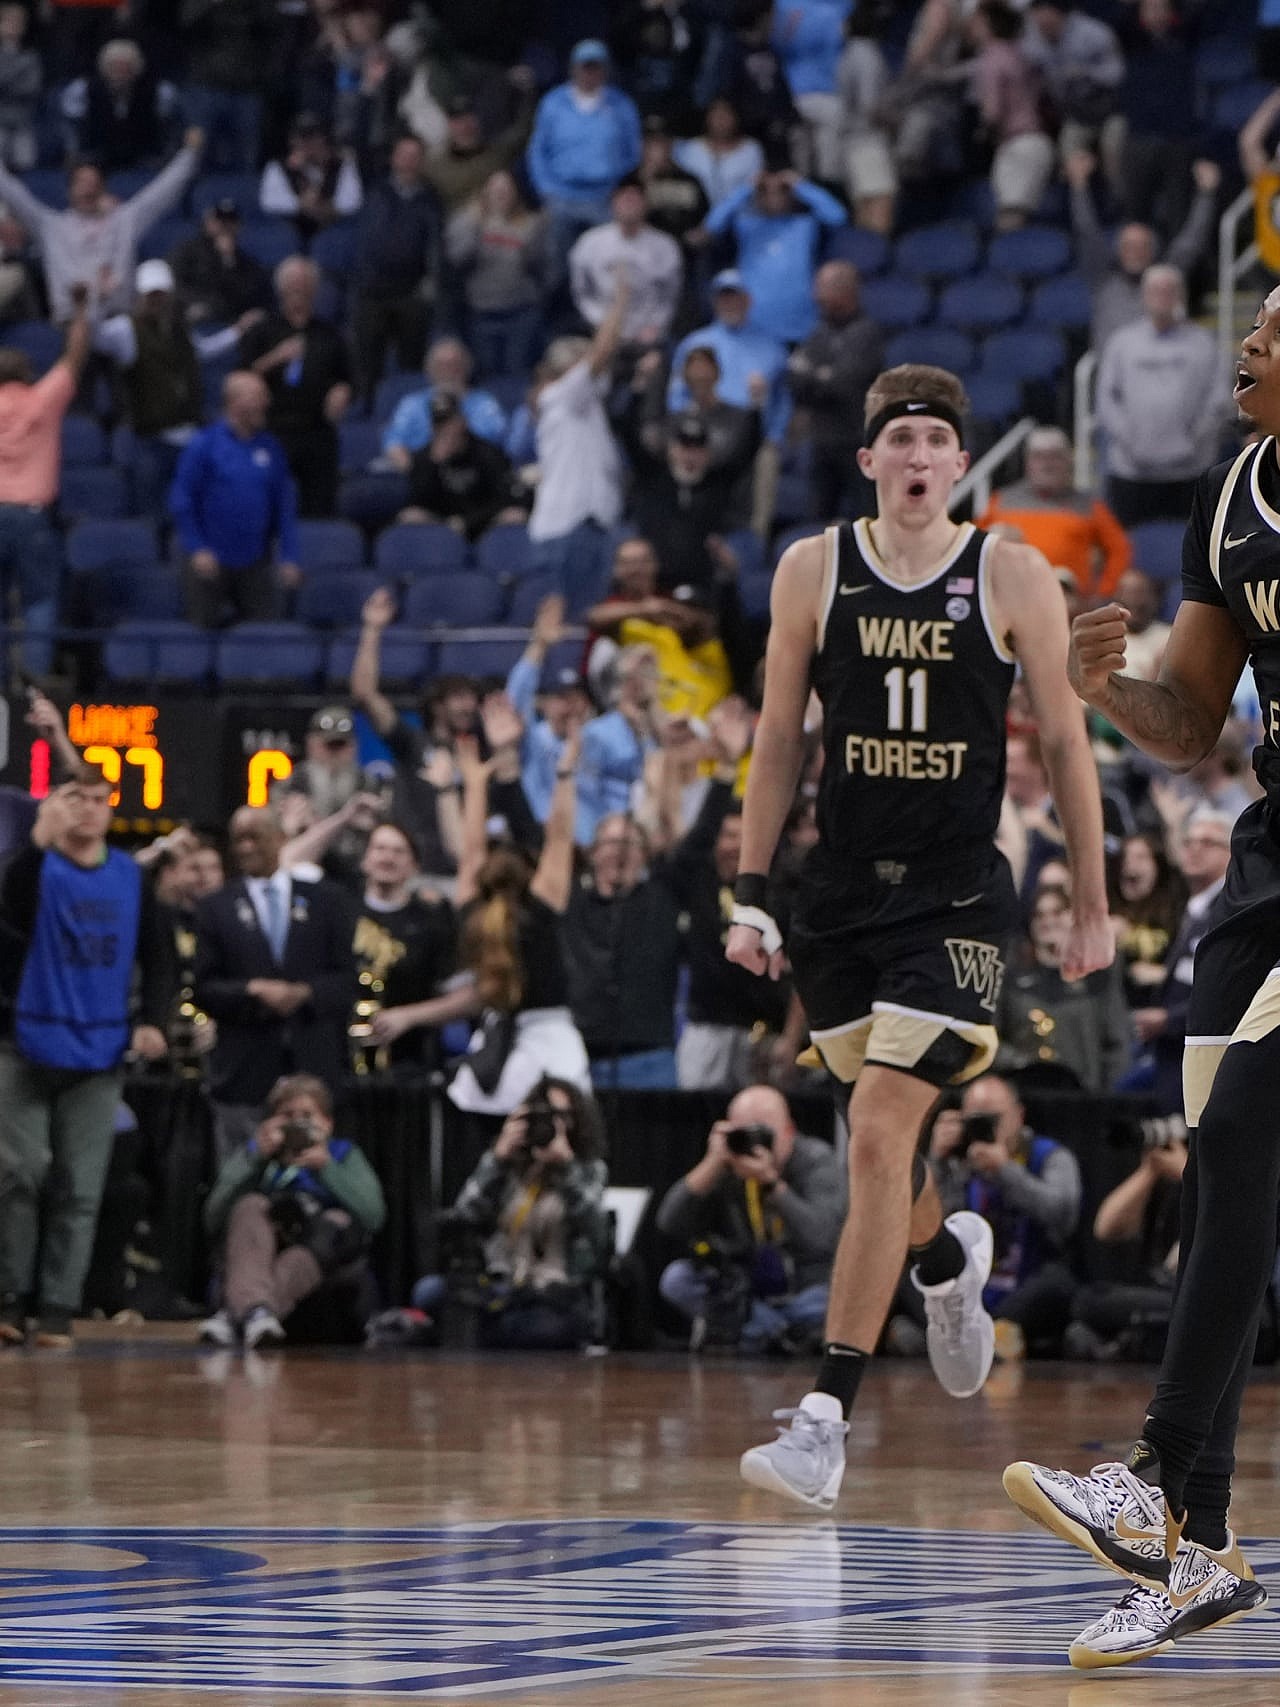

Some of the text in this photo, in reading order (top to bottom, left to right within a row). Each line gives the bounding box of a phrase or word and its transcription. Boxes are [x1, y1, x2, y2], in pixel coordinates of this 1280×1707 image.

[857, 616, 955, 660] WAKE
[884, 667, 928, 732] 11
[845, 735, 968, 780] FOREST
